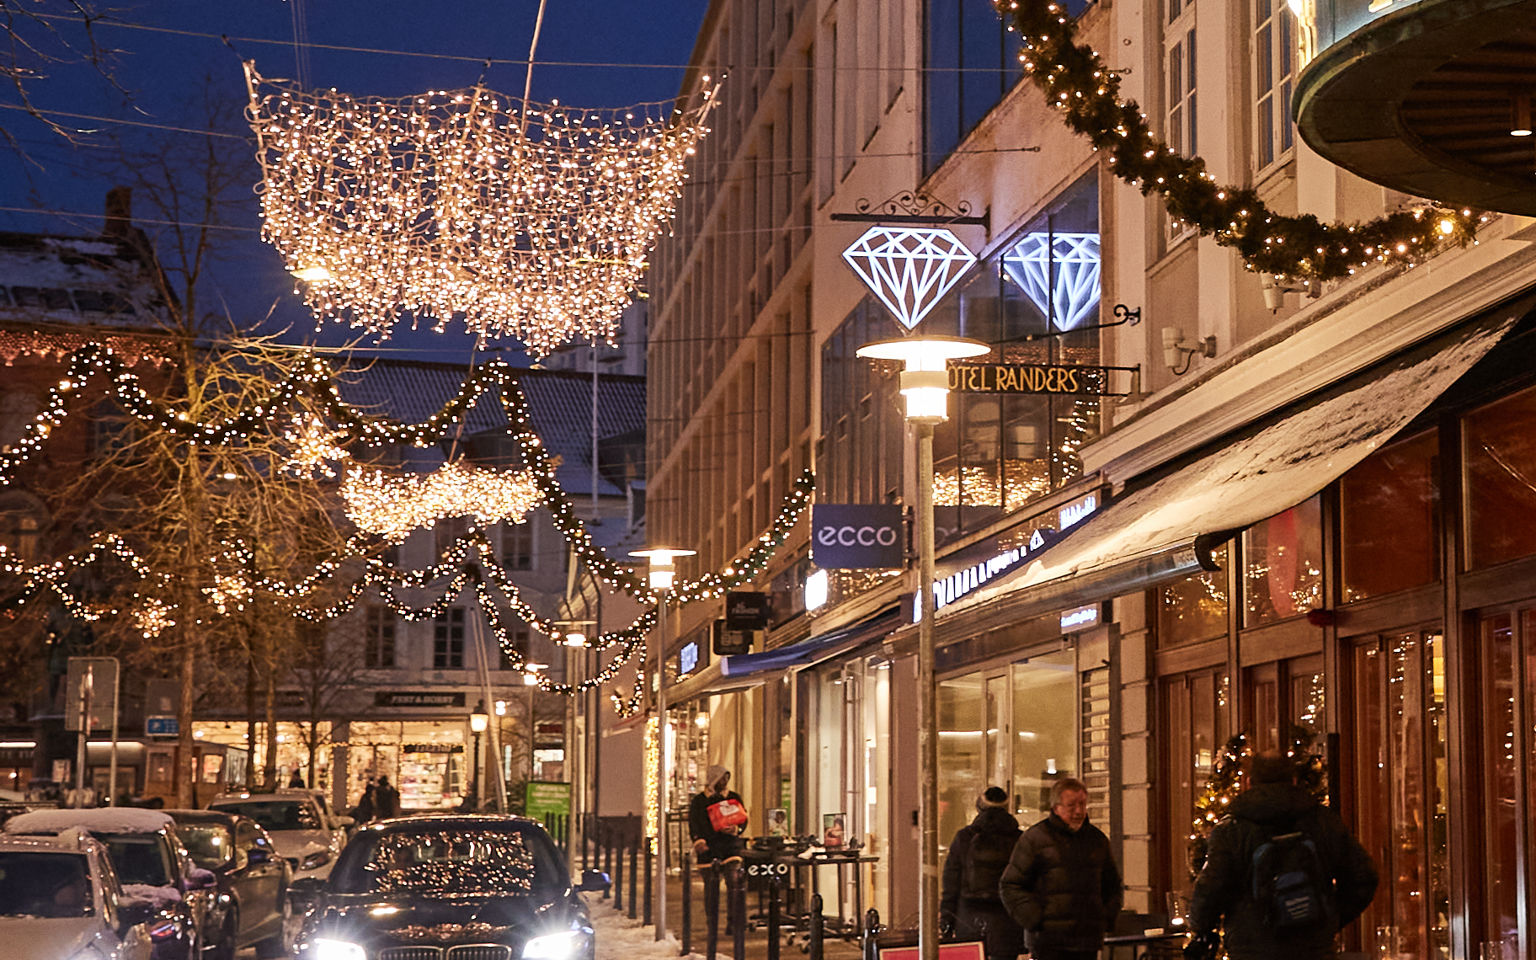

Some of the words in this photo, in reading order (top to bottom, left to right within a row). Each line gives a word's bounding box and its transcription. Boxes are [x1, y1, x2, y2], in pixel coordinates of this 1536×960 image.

[948, 365, 992, 390] OTEL
[995, 366, 1078, 393] RANDERS
[818, 526, 897, 546] ecco
